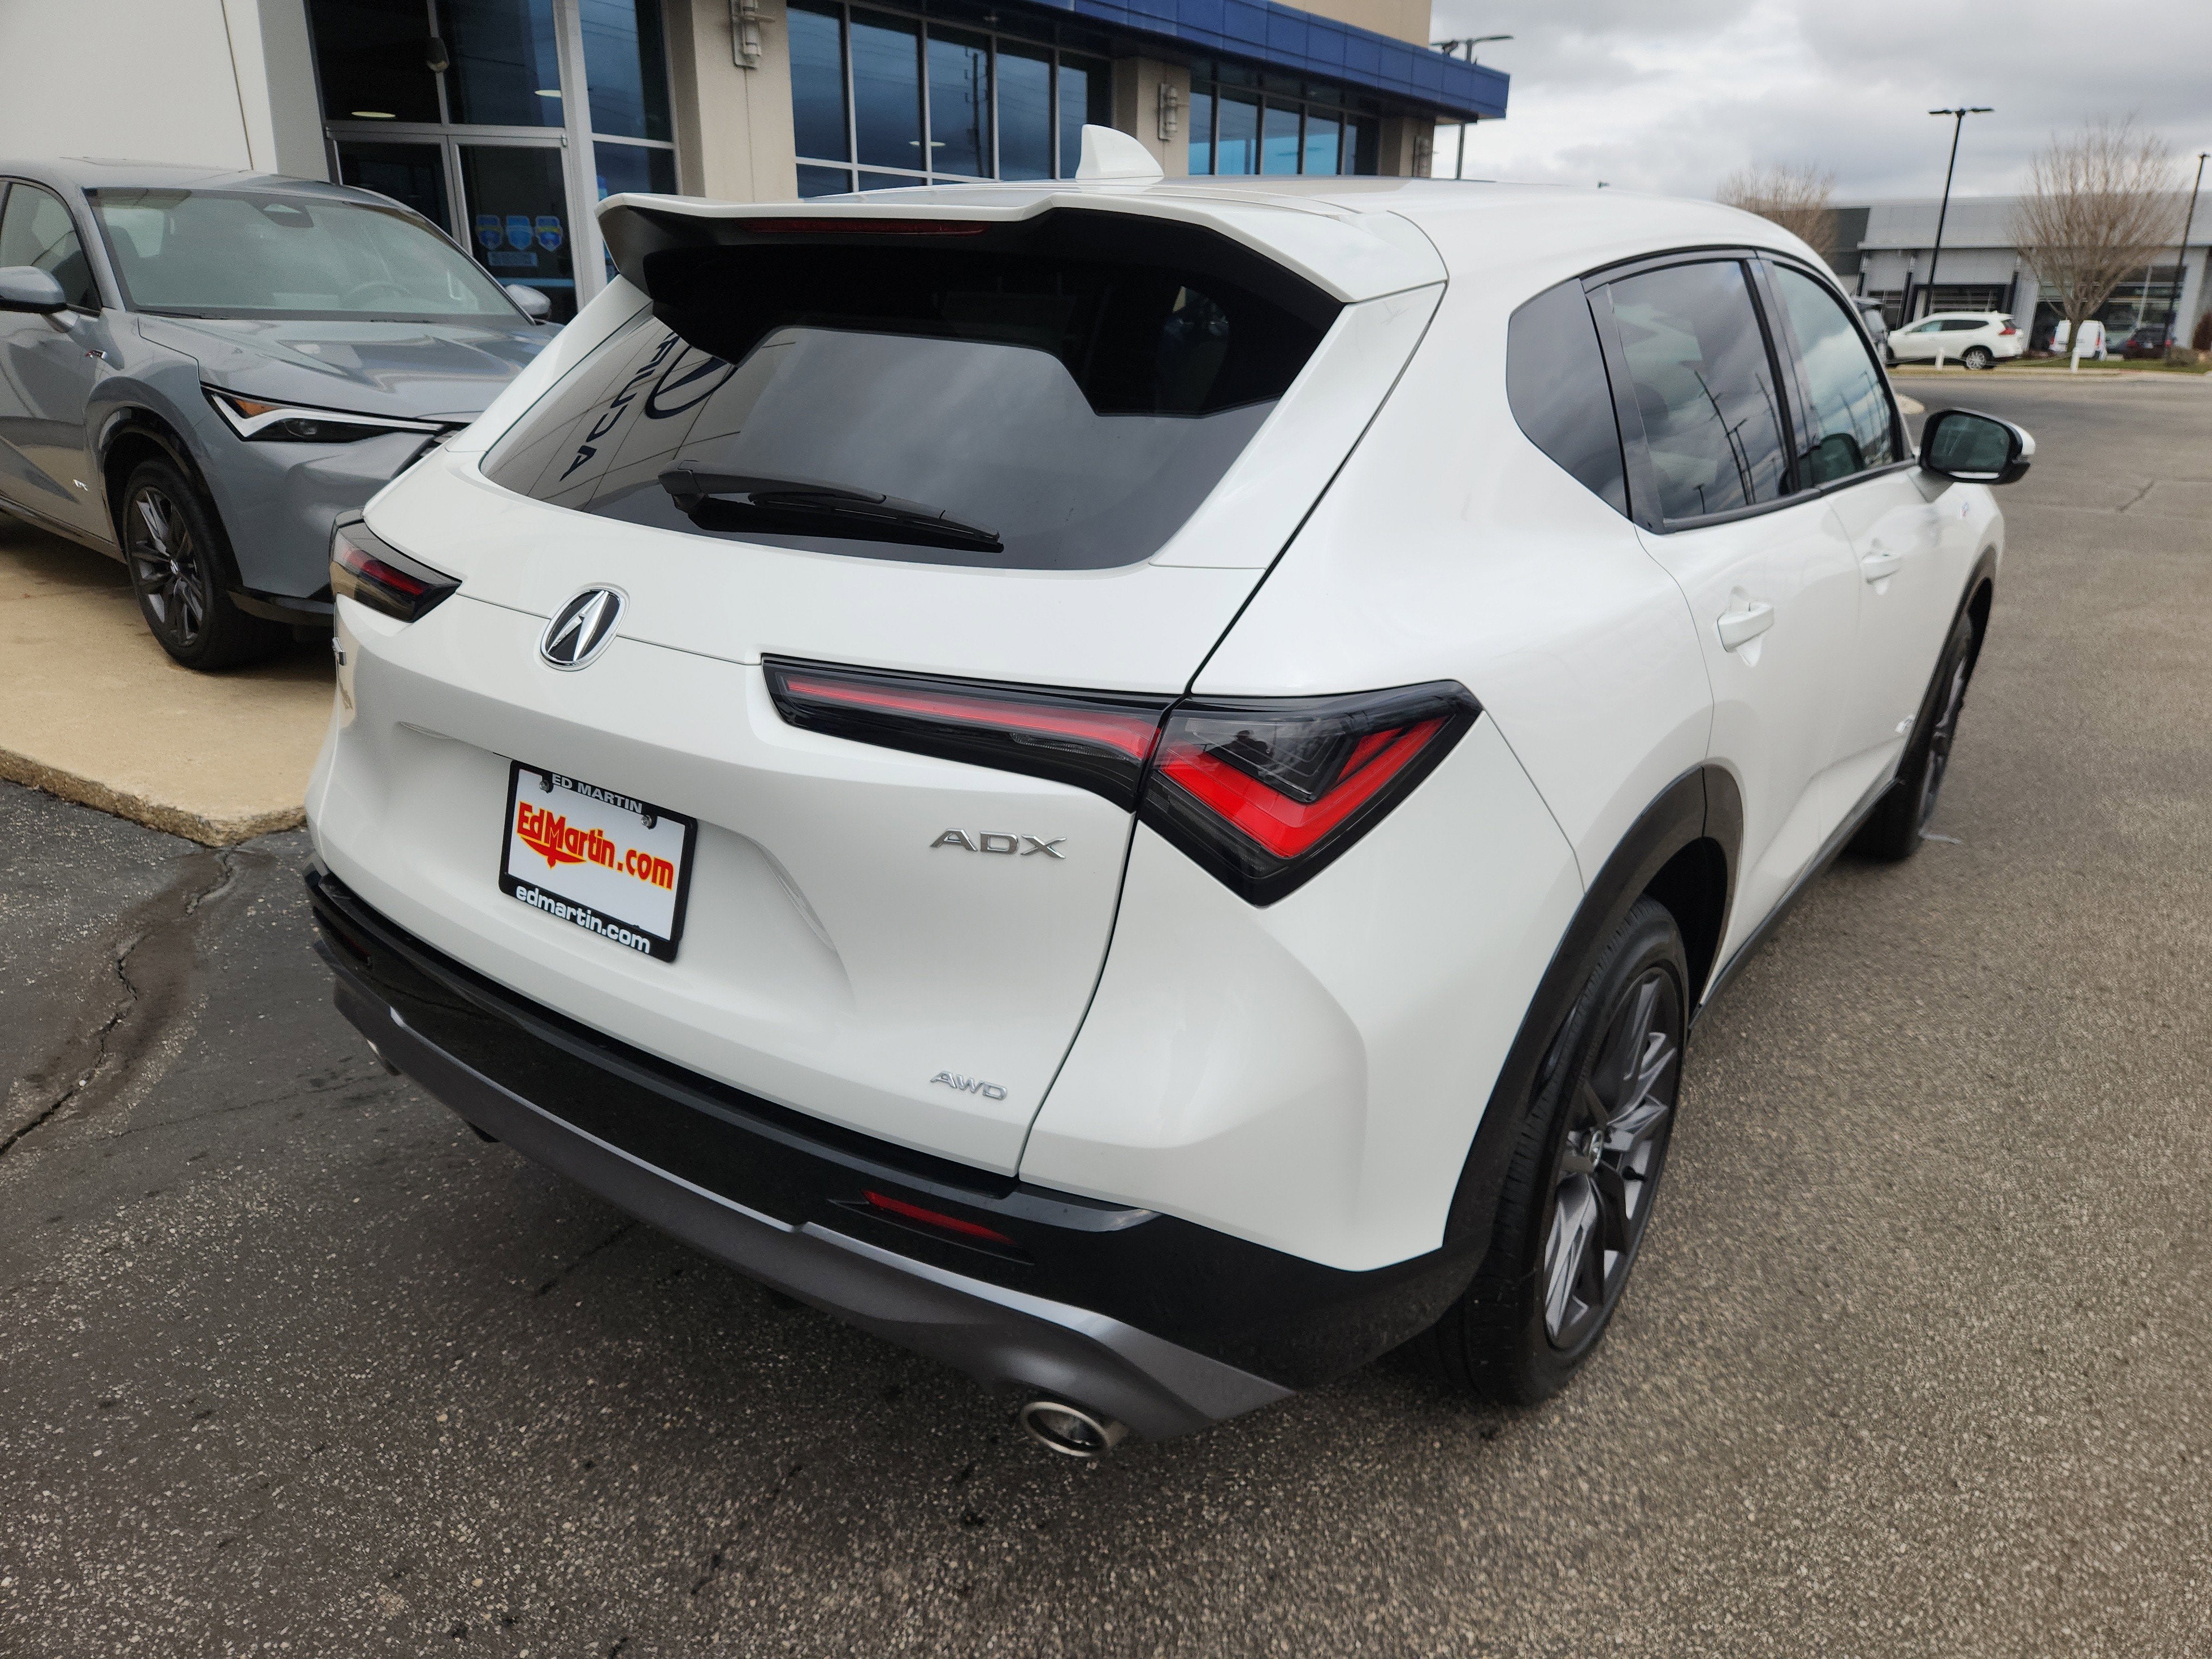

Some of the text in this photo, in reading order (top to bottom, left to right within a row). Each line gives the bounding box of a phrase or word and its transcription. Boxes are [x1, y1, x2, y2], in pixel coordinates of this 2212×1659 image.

[552, 773, 642, 814] ED MARTIN
[517, 801, 674, 891] EdMartin.com
[929, 827, 1067, 859] ADX
[516, 885, 651, 954] edmartin.com
[930, 1070, 1008, 1101] AWD
